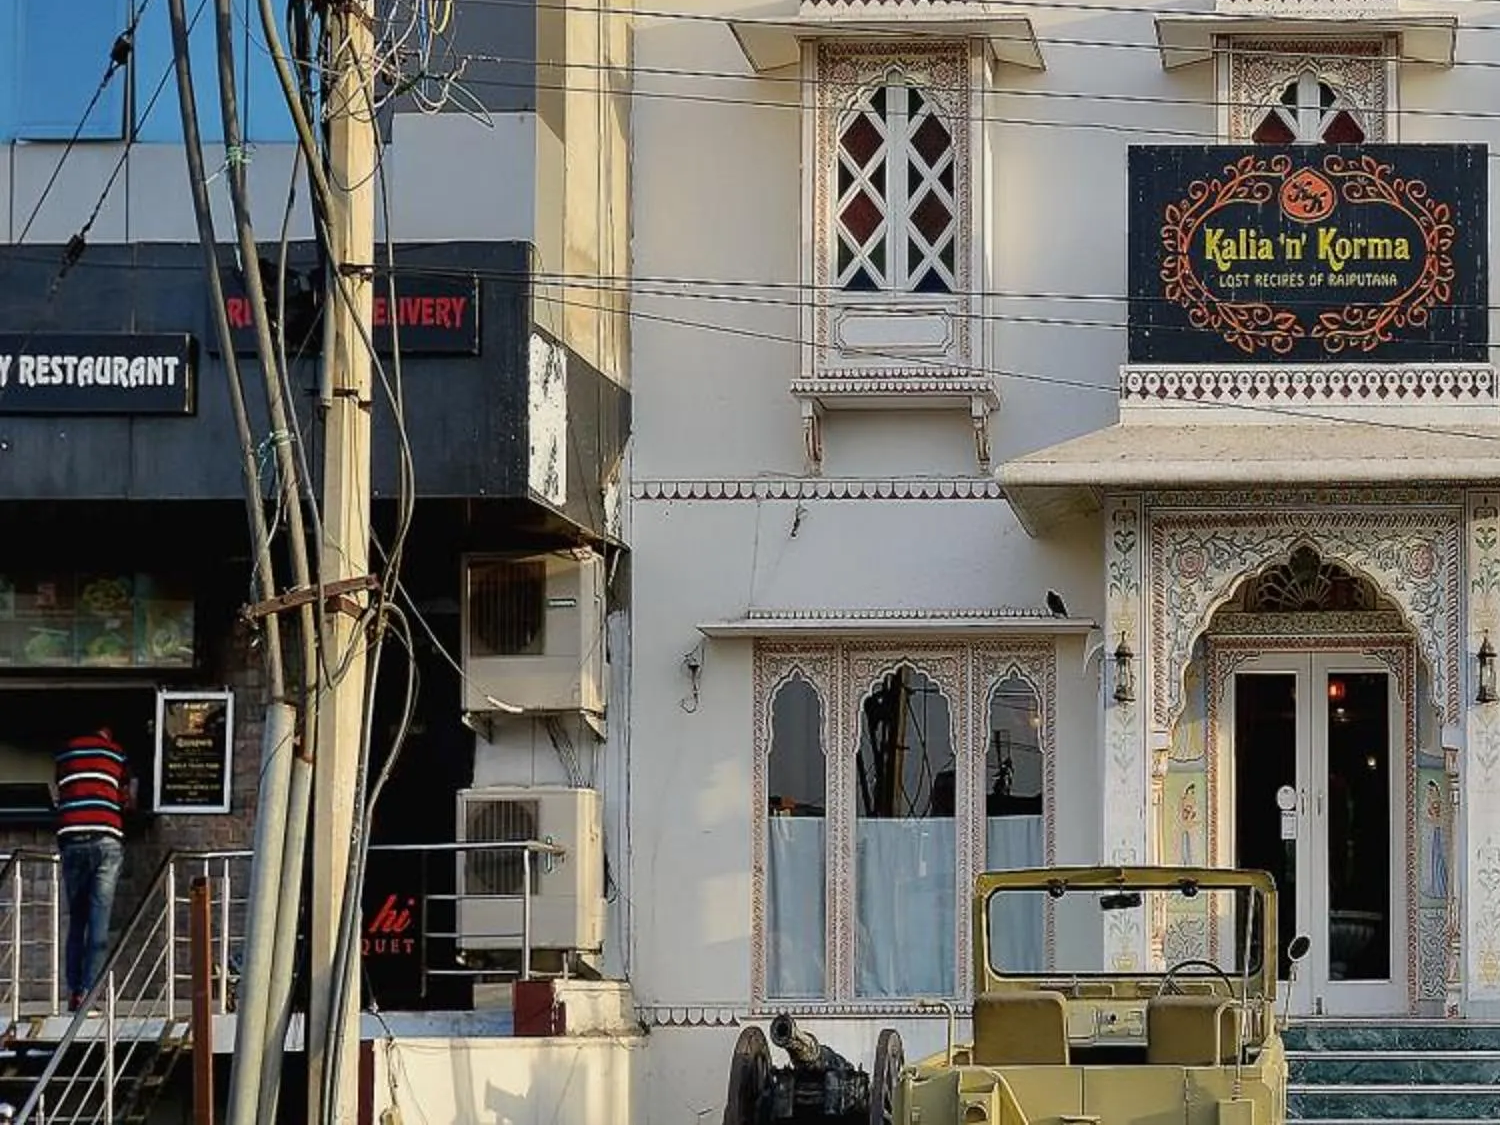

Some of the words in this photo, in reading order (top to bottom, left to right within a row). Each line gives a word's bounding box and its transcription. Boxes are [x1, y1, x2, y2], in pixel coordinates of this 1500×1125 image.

[1204, 227, 1275, 272] Kalia
[1317, 227, 1411, 272] Korma
[1218, 273, 1250, 288] LOST
[1254, 273, 1304, 288] RECIPES
[1308, 273, 1324, 288] OF
[1327, 273, 1398, 288] RAJPUTANA
[18, 354, 180, 388] RESTAURANT
